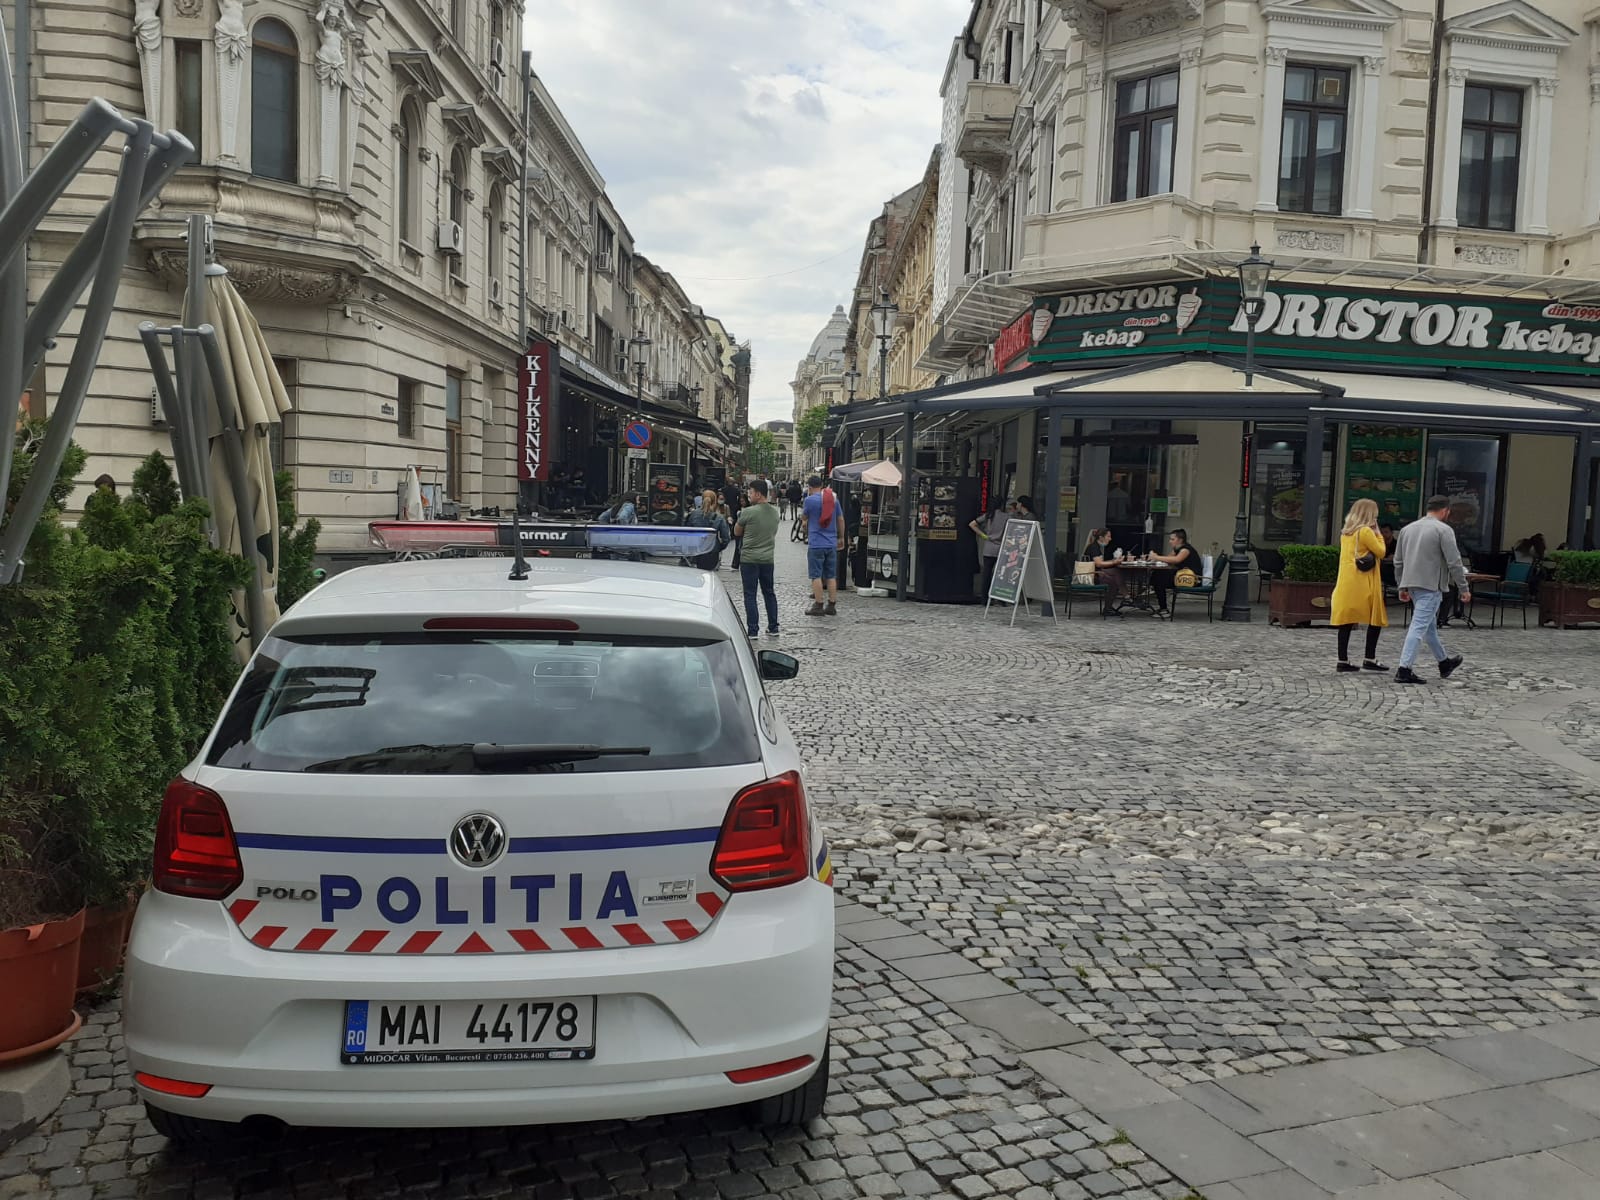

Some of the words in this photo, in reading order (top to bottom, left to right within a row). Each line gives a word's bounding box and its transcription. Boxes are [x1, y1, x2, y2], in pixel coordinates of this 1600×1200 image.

[1055, 285, 1178, 317] DRISTOR
[1546, 304, 1570, 317] din
[1228, 292, 1493, 348] DRISTOR
[1080, 330, 1144, 348] kebap
[525, 355, 541, 479] KILKENNY
[257, 886, 318, 901] POLO
[320, 870, 638, 924] POLITIA
[379, 1005, 440, 1045] MAI
[466, 1002, 578, 1043] 44178
[347, 1030, 365, 1046] RO
[363, 1055, 410, 1063] MIDOCAR
